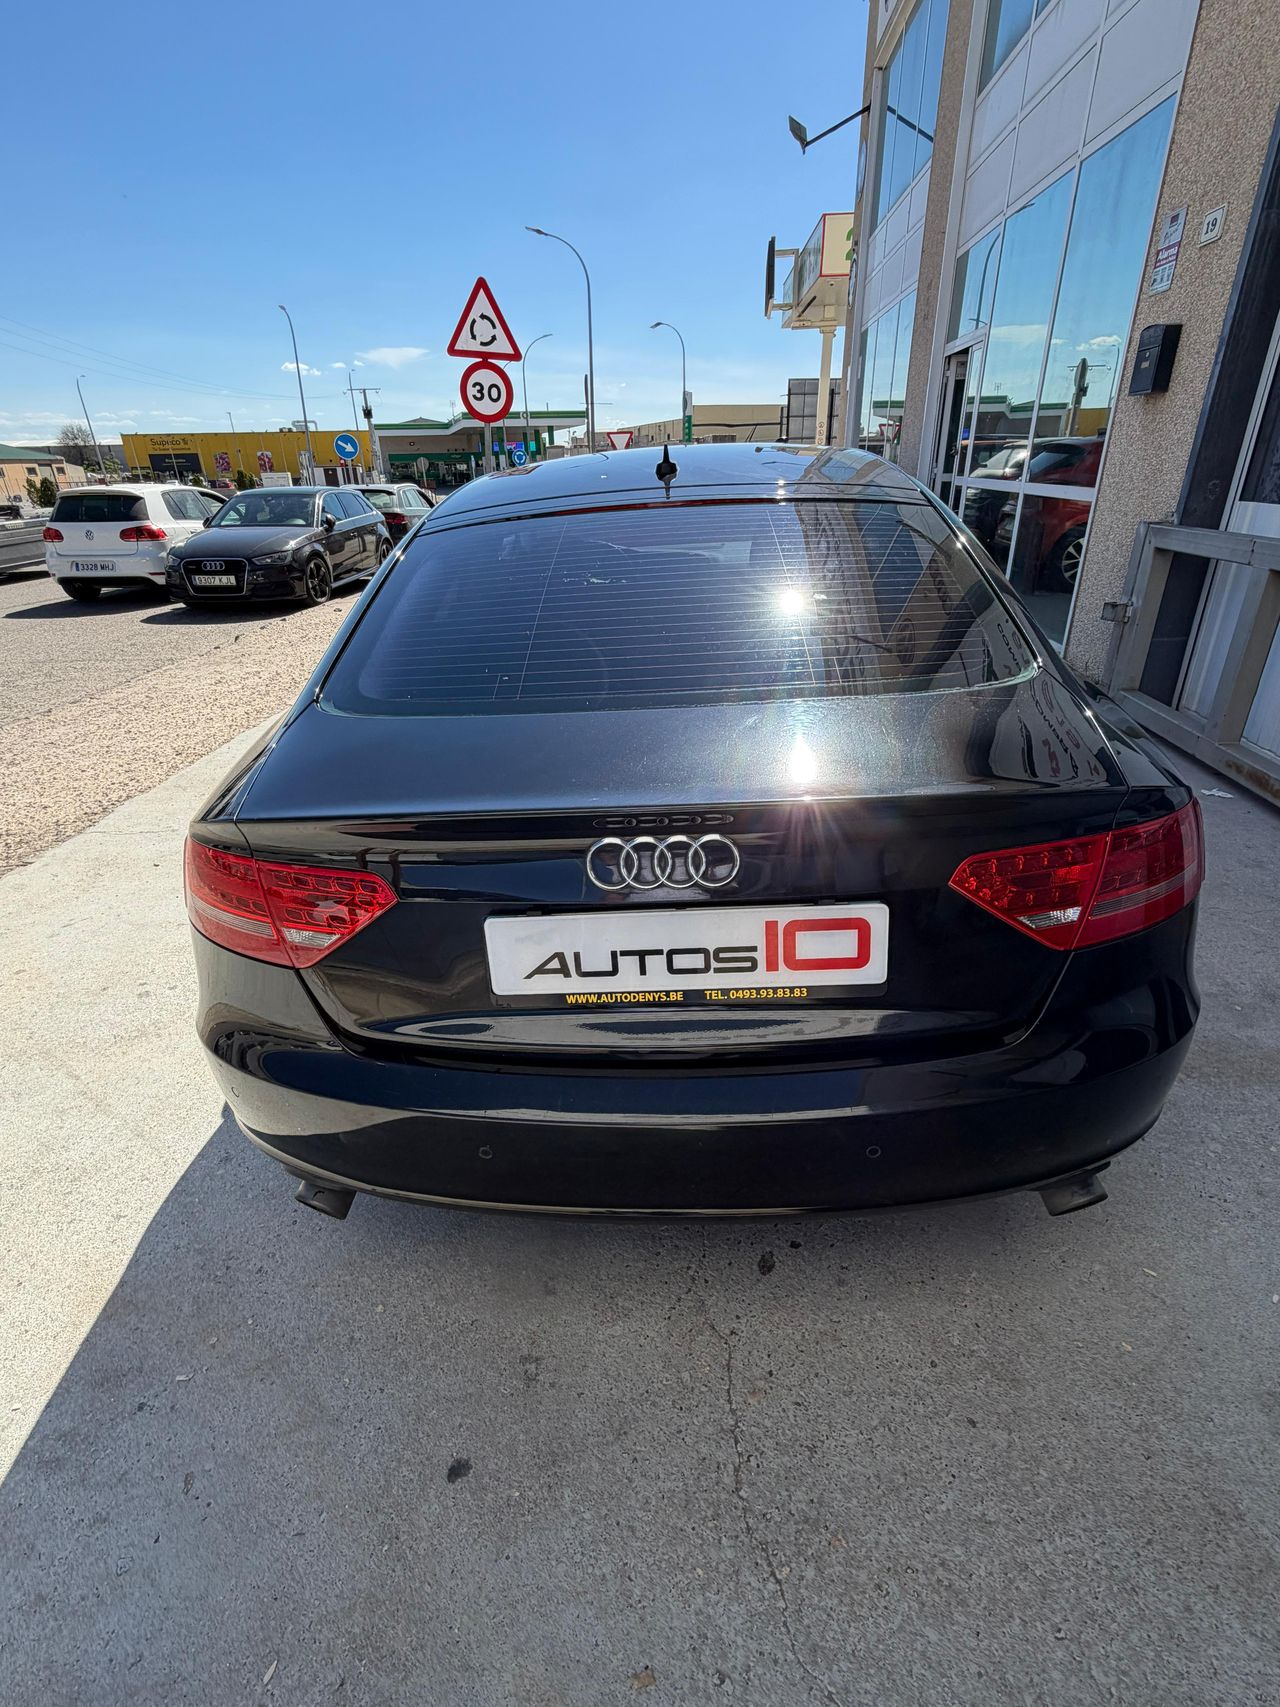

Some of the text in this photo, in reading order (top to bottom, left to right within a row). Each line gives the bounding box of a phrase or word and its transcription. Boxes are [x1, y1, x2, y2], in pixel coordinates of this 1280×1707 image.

[1204, 218, 1218, 235] 19
[471, 381, 502, 403] 30
[81, 563, 114, 571] 3328 MHJ
[197, 576, 217, 585] 9307
[566, 987, 808, 1004] WWW.AUTODENYS.BE TEL. 0493.93.83.83
